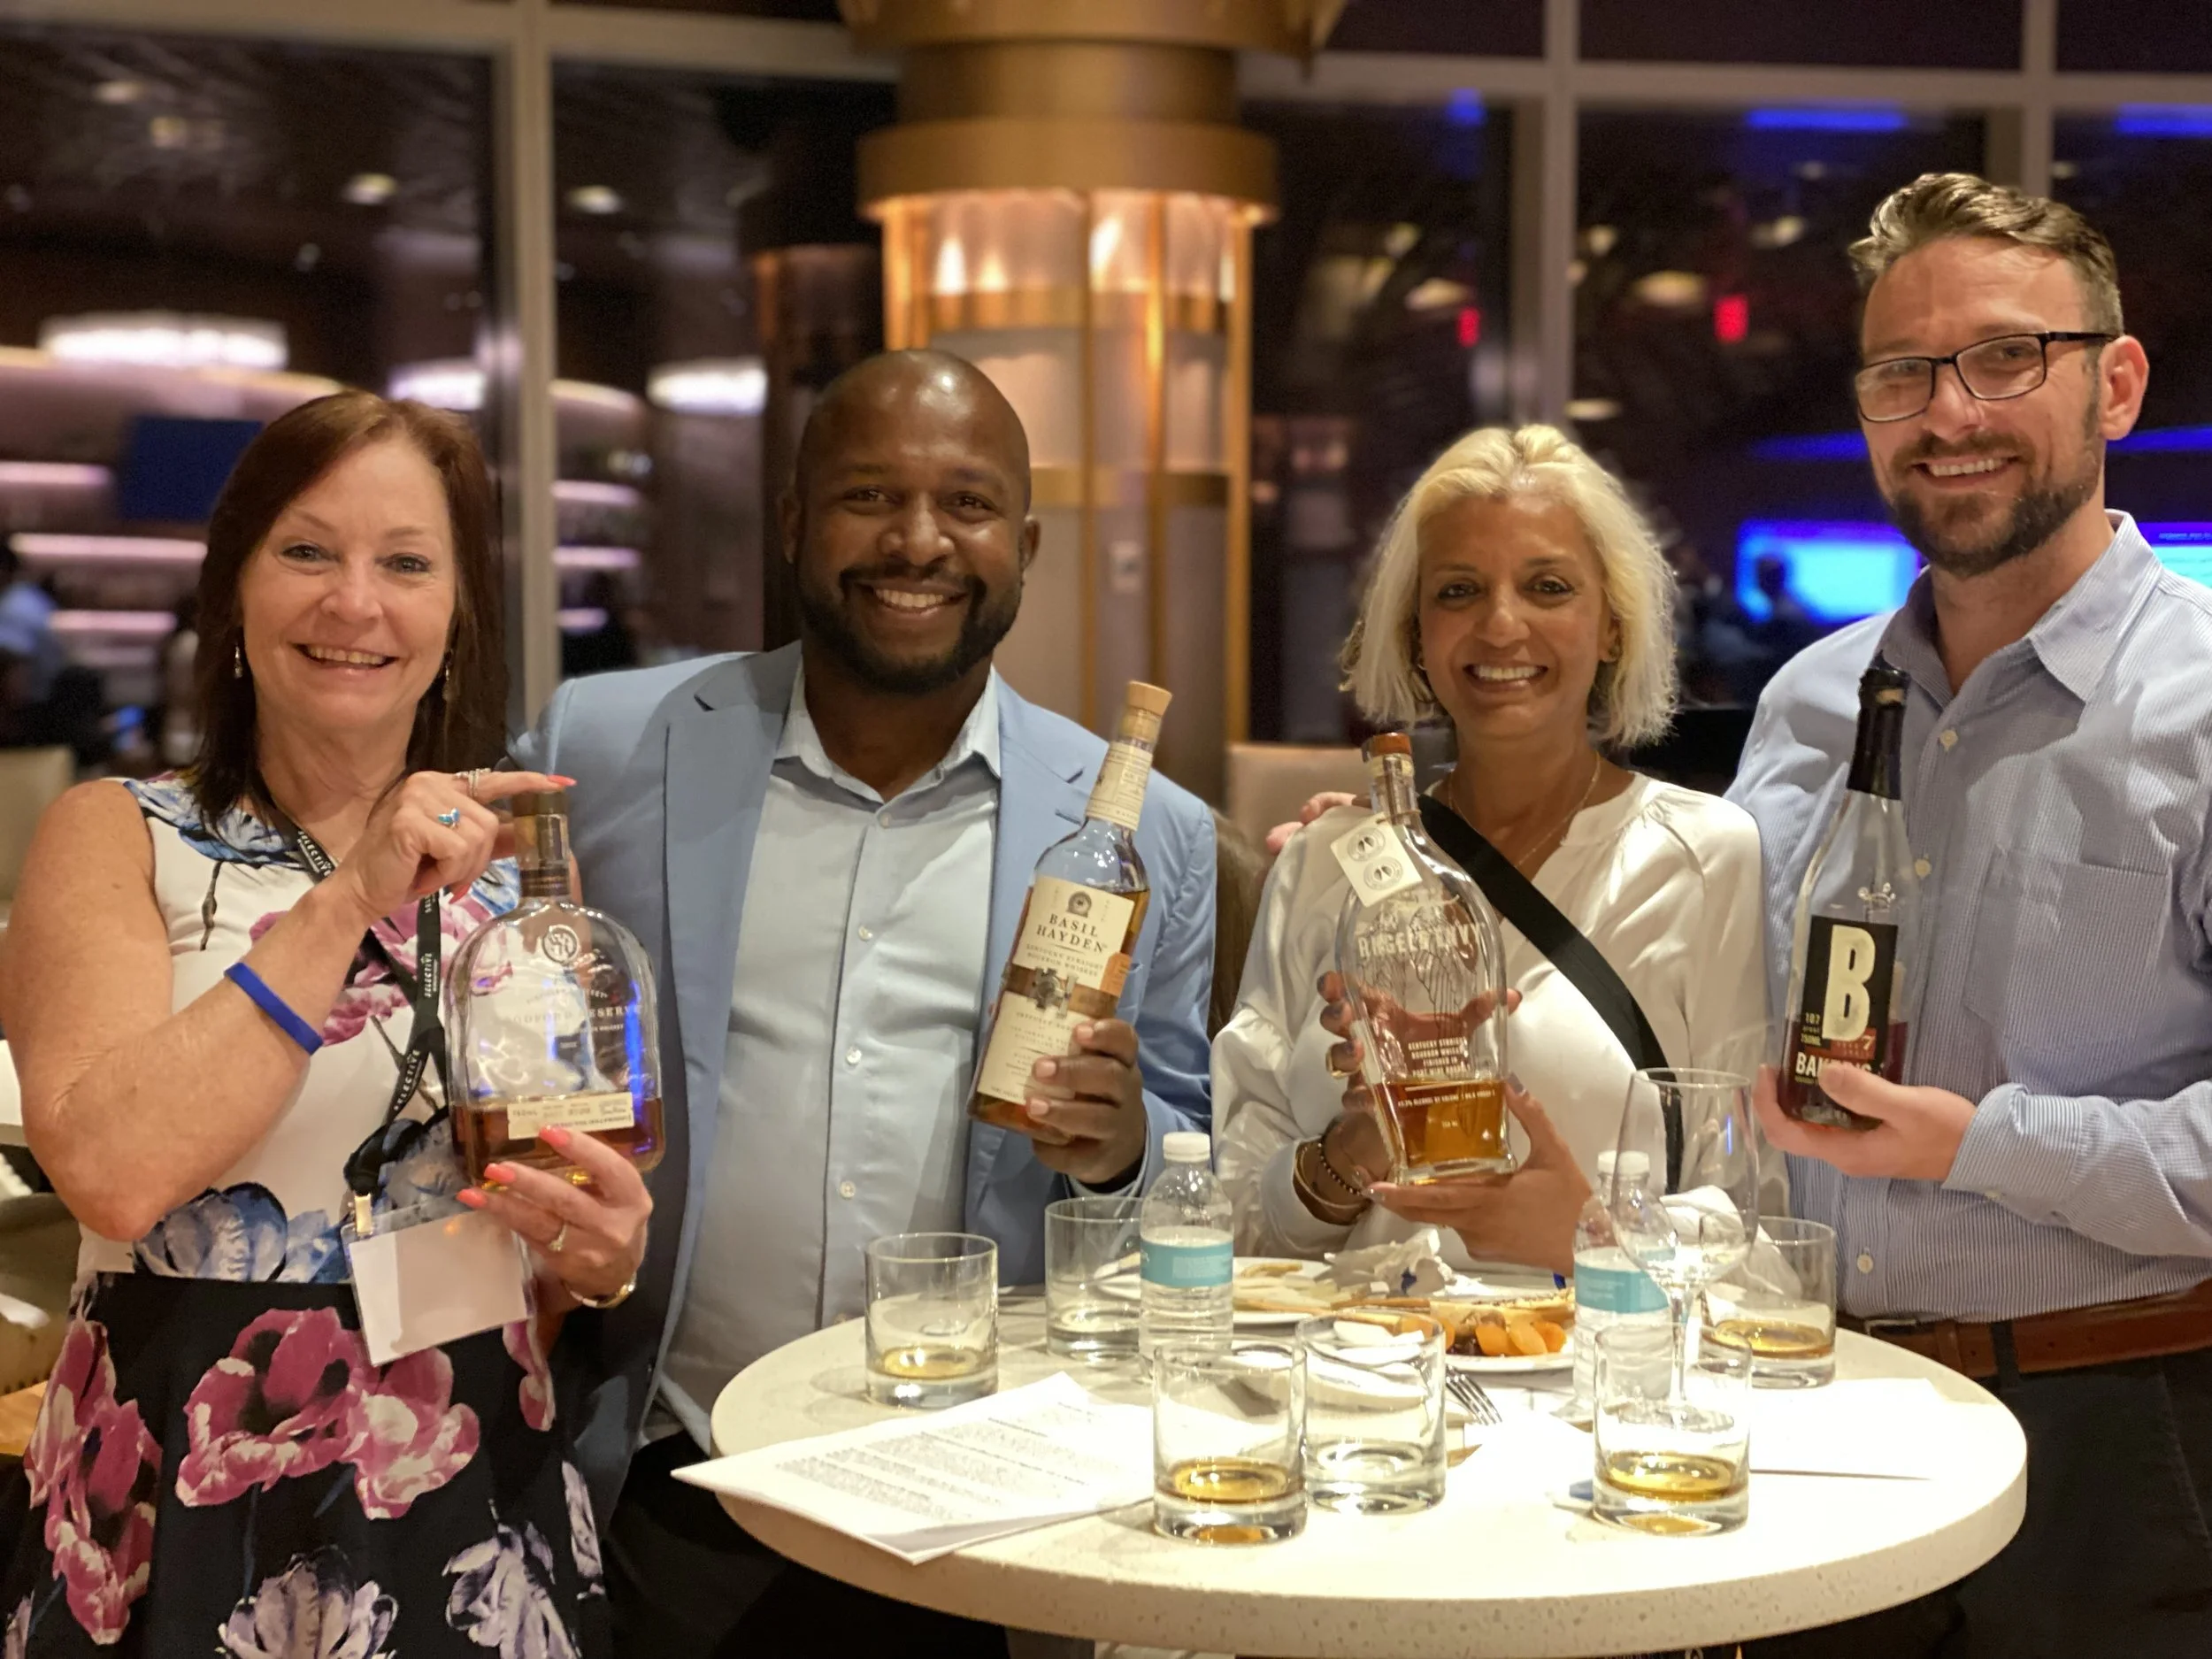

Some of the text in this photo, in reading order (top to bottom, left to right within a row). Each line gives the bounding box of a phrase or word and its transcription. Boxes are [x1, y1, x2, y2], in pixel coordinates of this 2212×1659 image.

[297, 831, 332, 877] SELECTIVE
[1035, 925, 1104, 954] HAYDEN
[1049, 913, 1098, 938] BASIL
[424, 953, 433, 998] SELECTIVE
[1822, 924, 1876, 1042] B
[1861, 1034, 1876, 1051] 7
[394, 1049, 420, 1111] SELECTIVE
